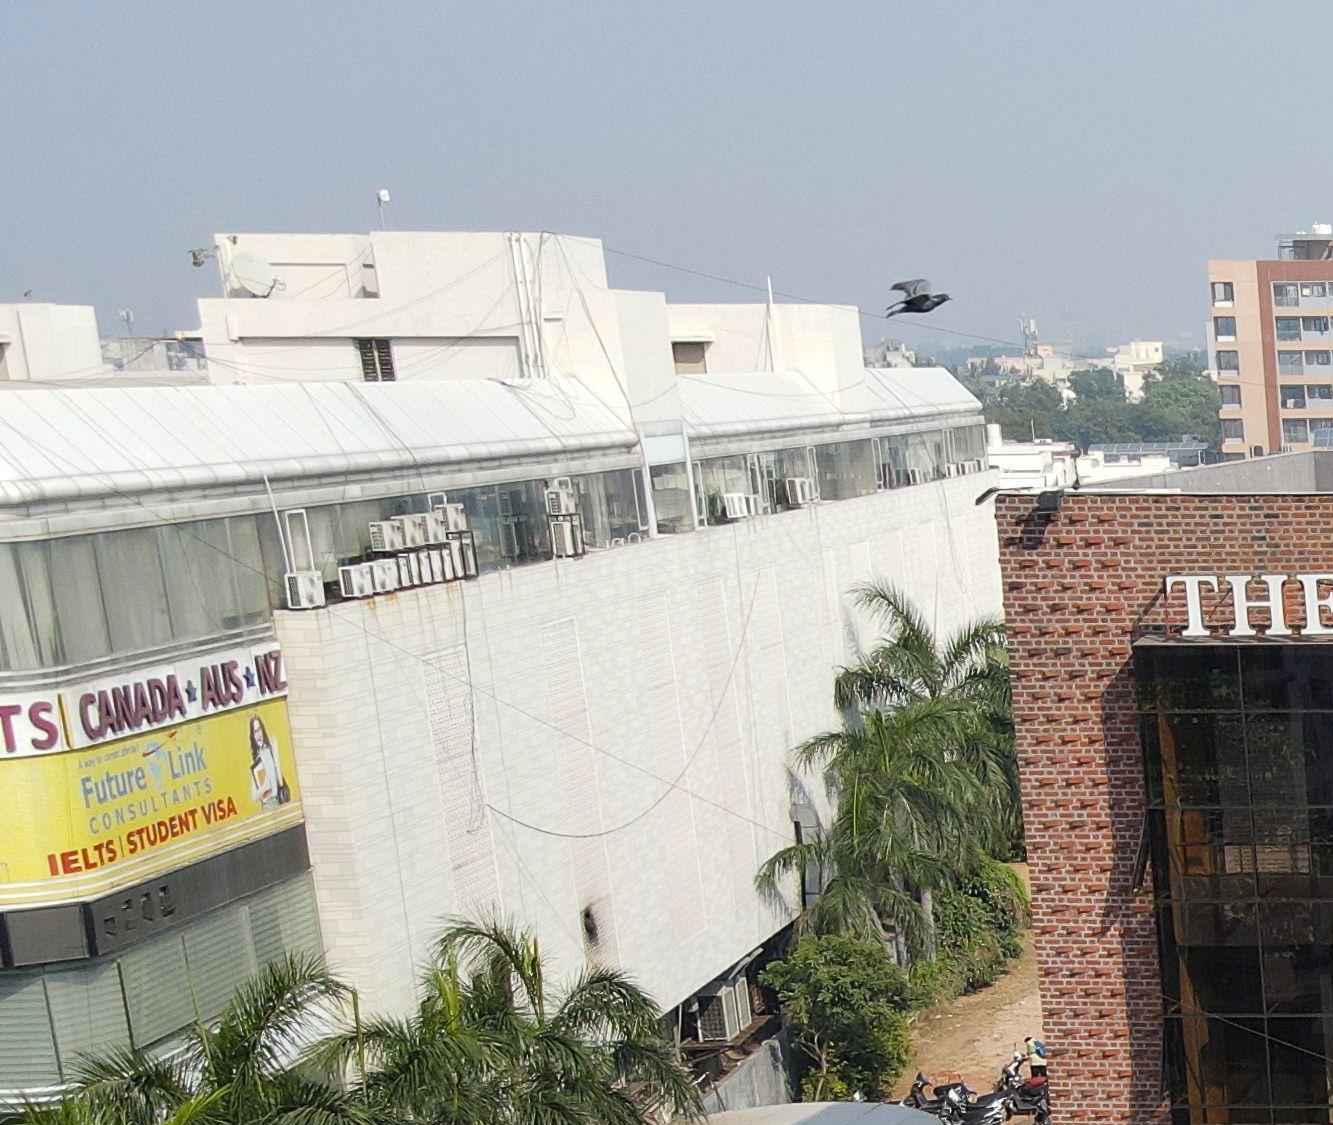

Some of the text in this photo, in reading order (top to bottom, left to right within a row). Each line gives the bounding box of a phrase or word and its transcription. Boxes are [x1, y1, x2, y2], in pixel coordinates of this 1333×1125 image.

[79, 674, 187, 740] CANADA
[200, 660, 244, 711] AUS
[254, 650, 288, 695] NZ
[81, 742, 207, 809] Future Link
[89, 777, 212, 834] CONSULTANTS
[47, 796, 237, 876] IELTS STUDENT VISA
